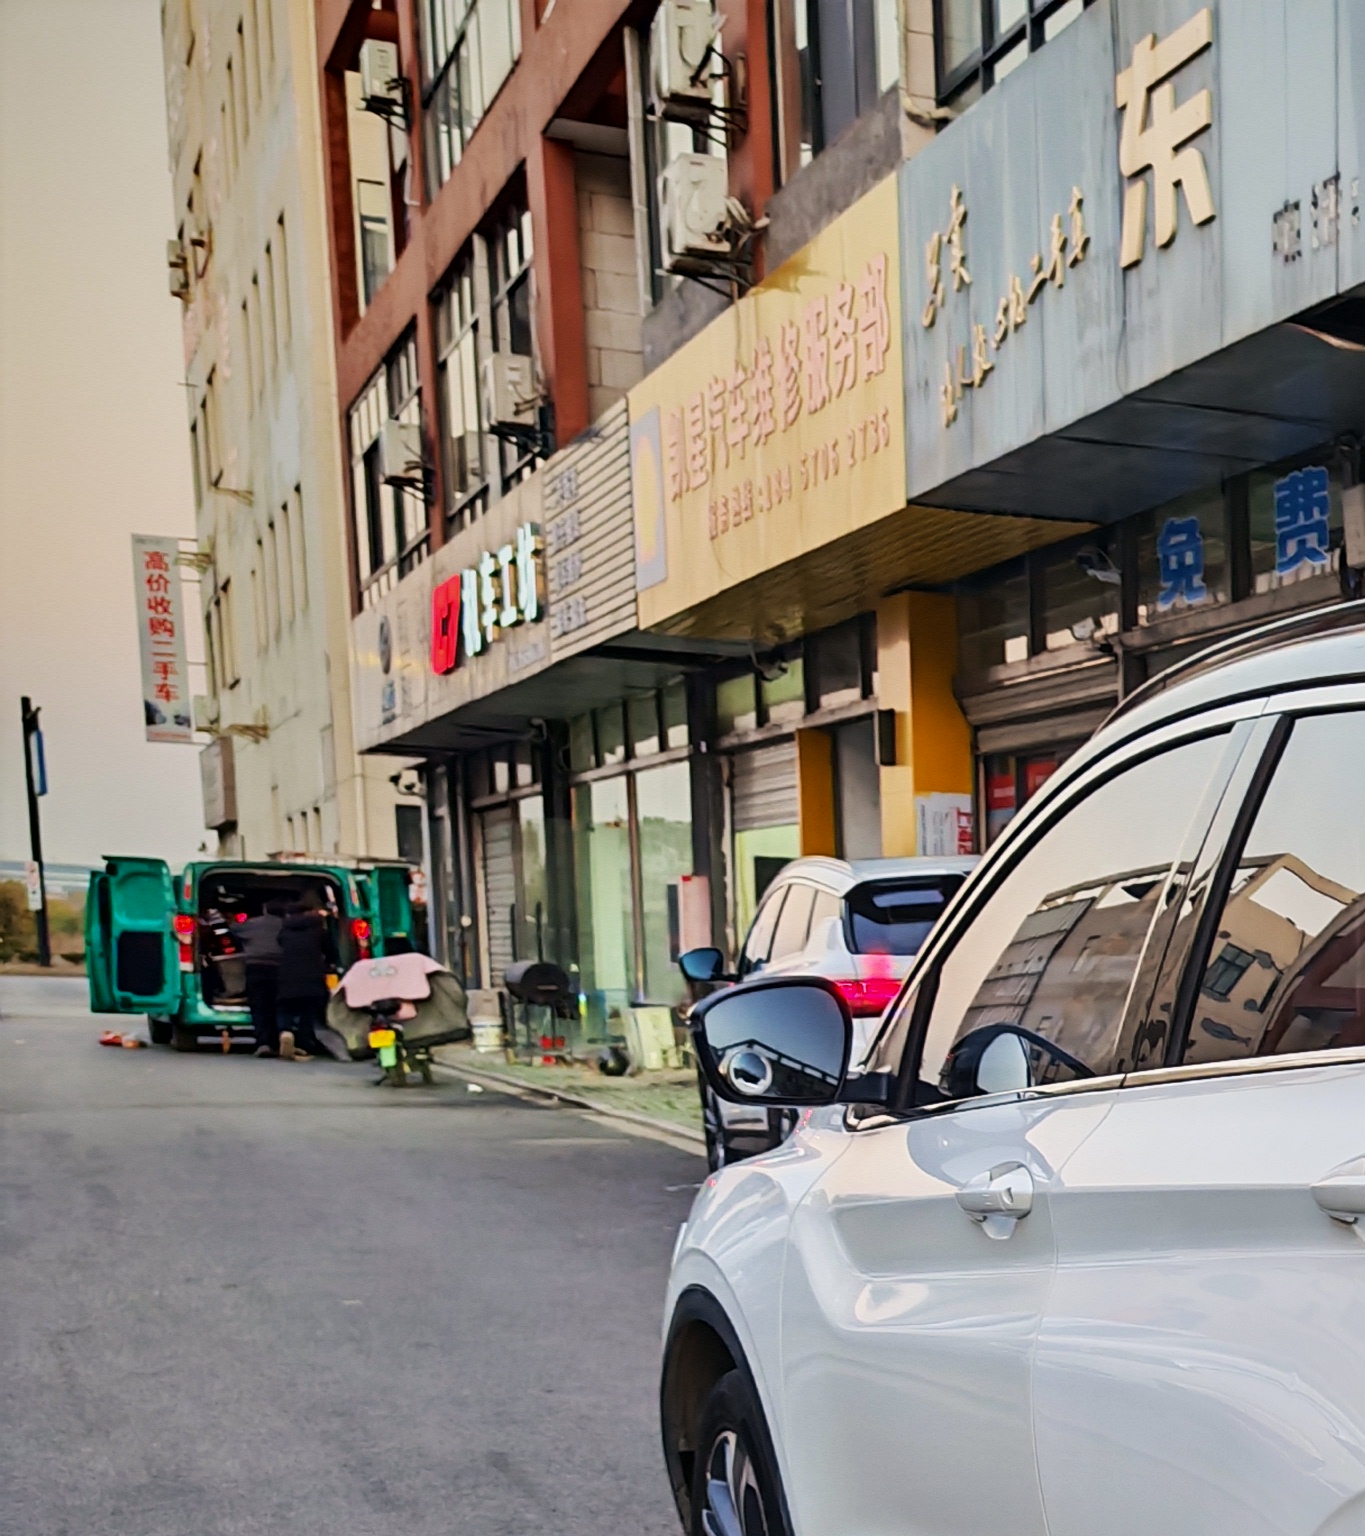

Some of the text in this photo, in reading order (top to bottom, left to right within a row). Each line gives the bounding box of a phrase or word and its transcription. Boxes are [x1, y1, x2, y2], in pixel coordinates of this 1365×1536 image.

[143, 550, 181, 703] 高价收购二手车
